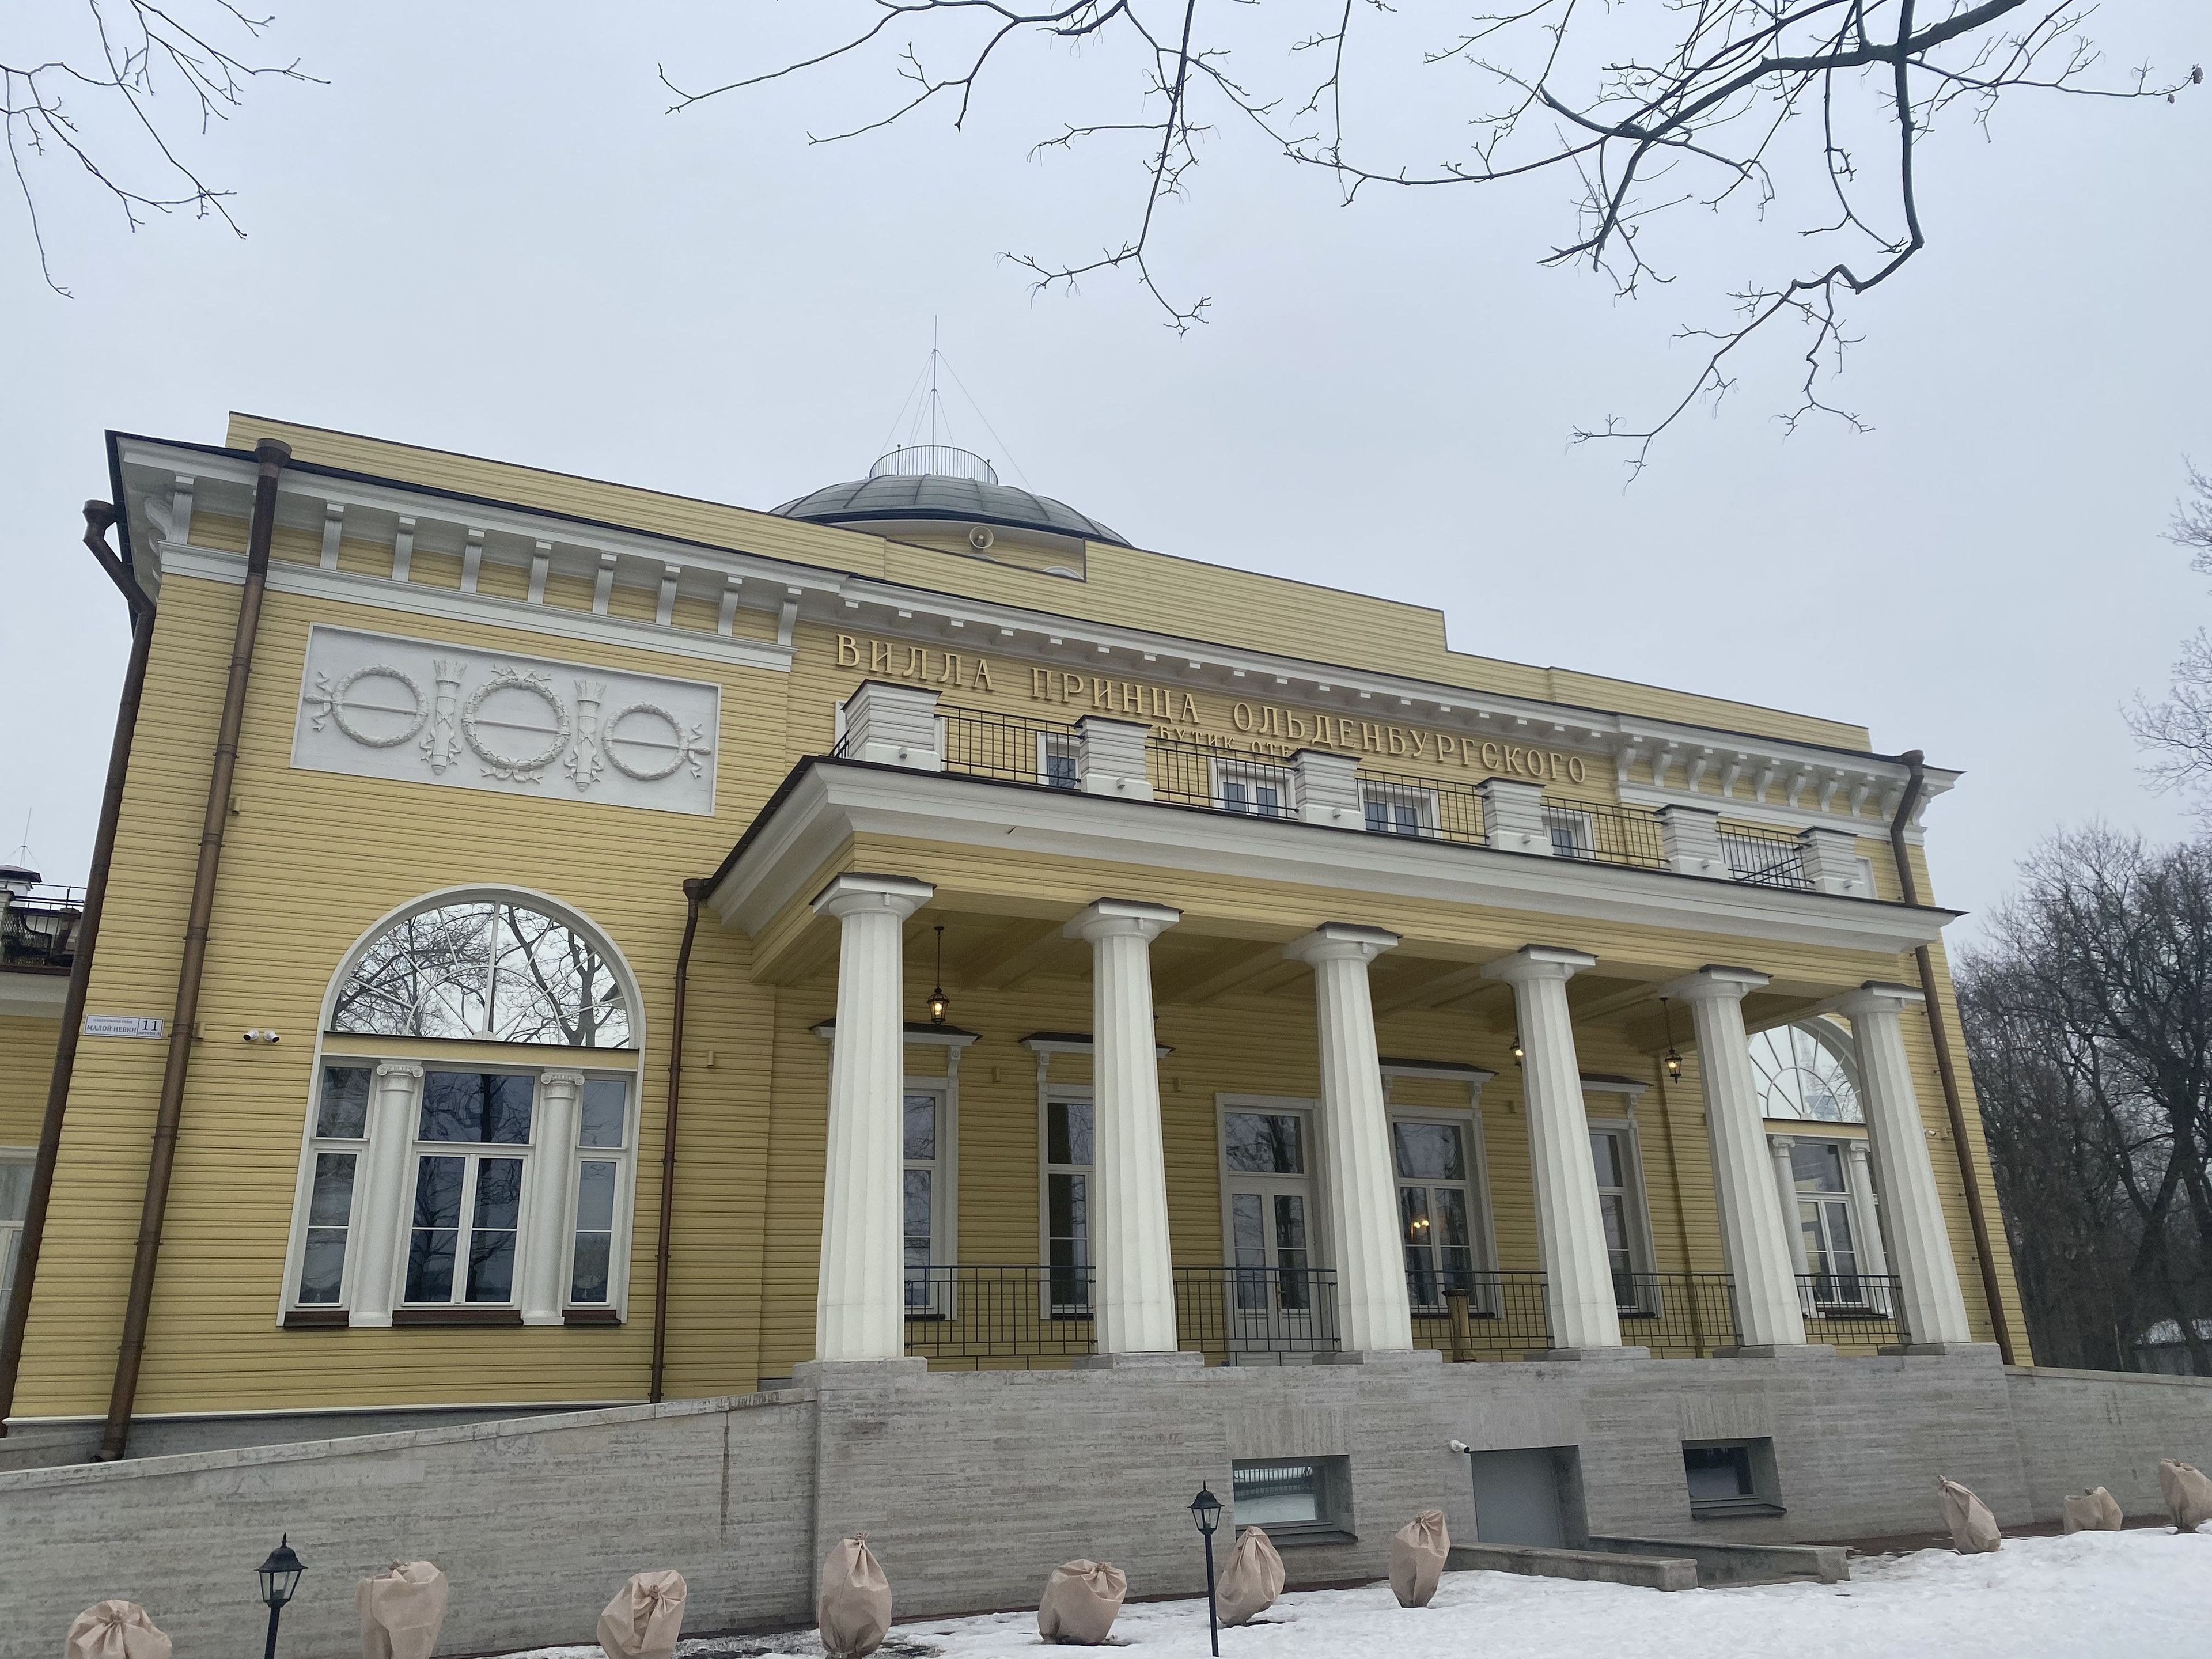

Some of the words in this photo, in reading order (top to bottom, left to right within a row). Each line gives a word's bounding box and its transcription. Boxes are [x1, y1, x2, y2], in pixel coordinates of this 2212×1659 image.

[836, 634, 994, 691] ВИЛЛА
[1031, 667, 1200, 724] ПРИНЦА
[1233, 702, 1586, 783] ОЛЬДЕНБУРГСКОГО
[1158, 726, 1234, 749] БУТИК
[1252, 740, 1296, 757] ОТЕ
[142, 1020, 157, 1031] 11
